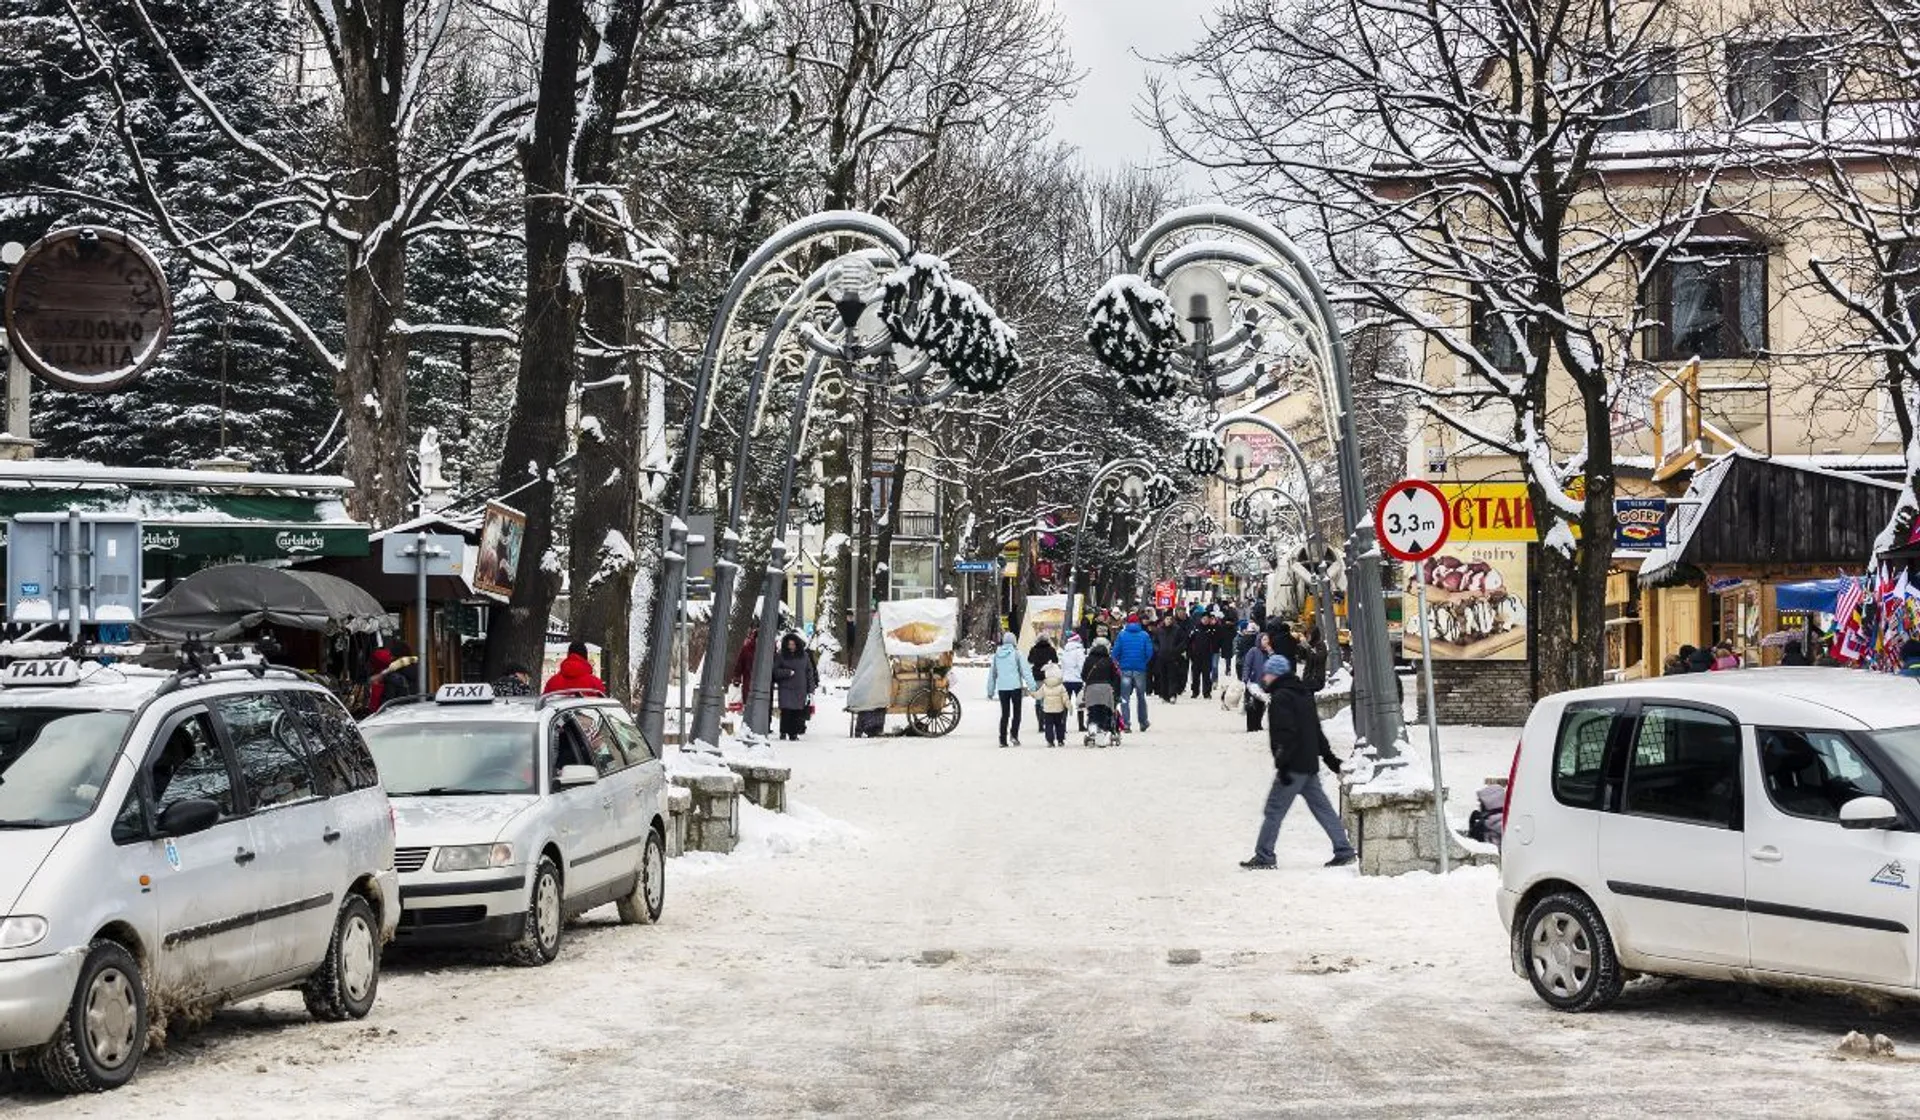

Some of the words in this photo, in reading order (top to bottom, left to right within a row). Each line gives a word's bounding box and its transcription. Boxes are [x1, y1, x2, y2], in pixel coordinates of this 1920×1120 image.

[1618, 509, 1662, 523] GOFRY
[142, 530, 180, 551] rlsberg
[275, 531, 325, 553] Carlsberg
[1472, 546, 1516, 562] gofry
[12, 661, 68, 677] TAXI
[445, 685, 484, 697] TAXI
